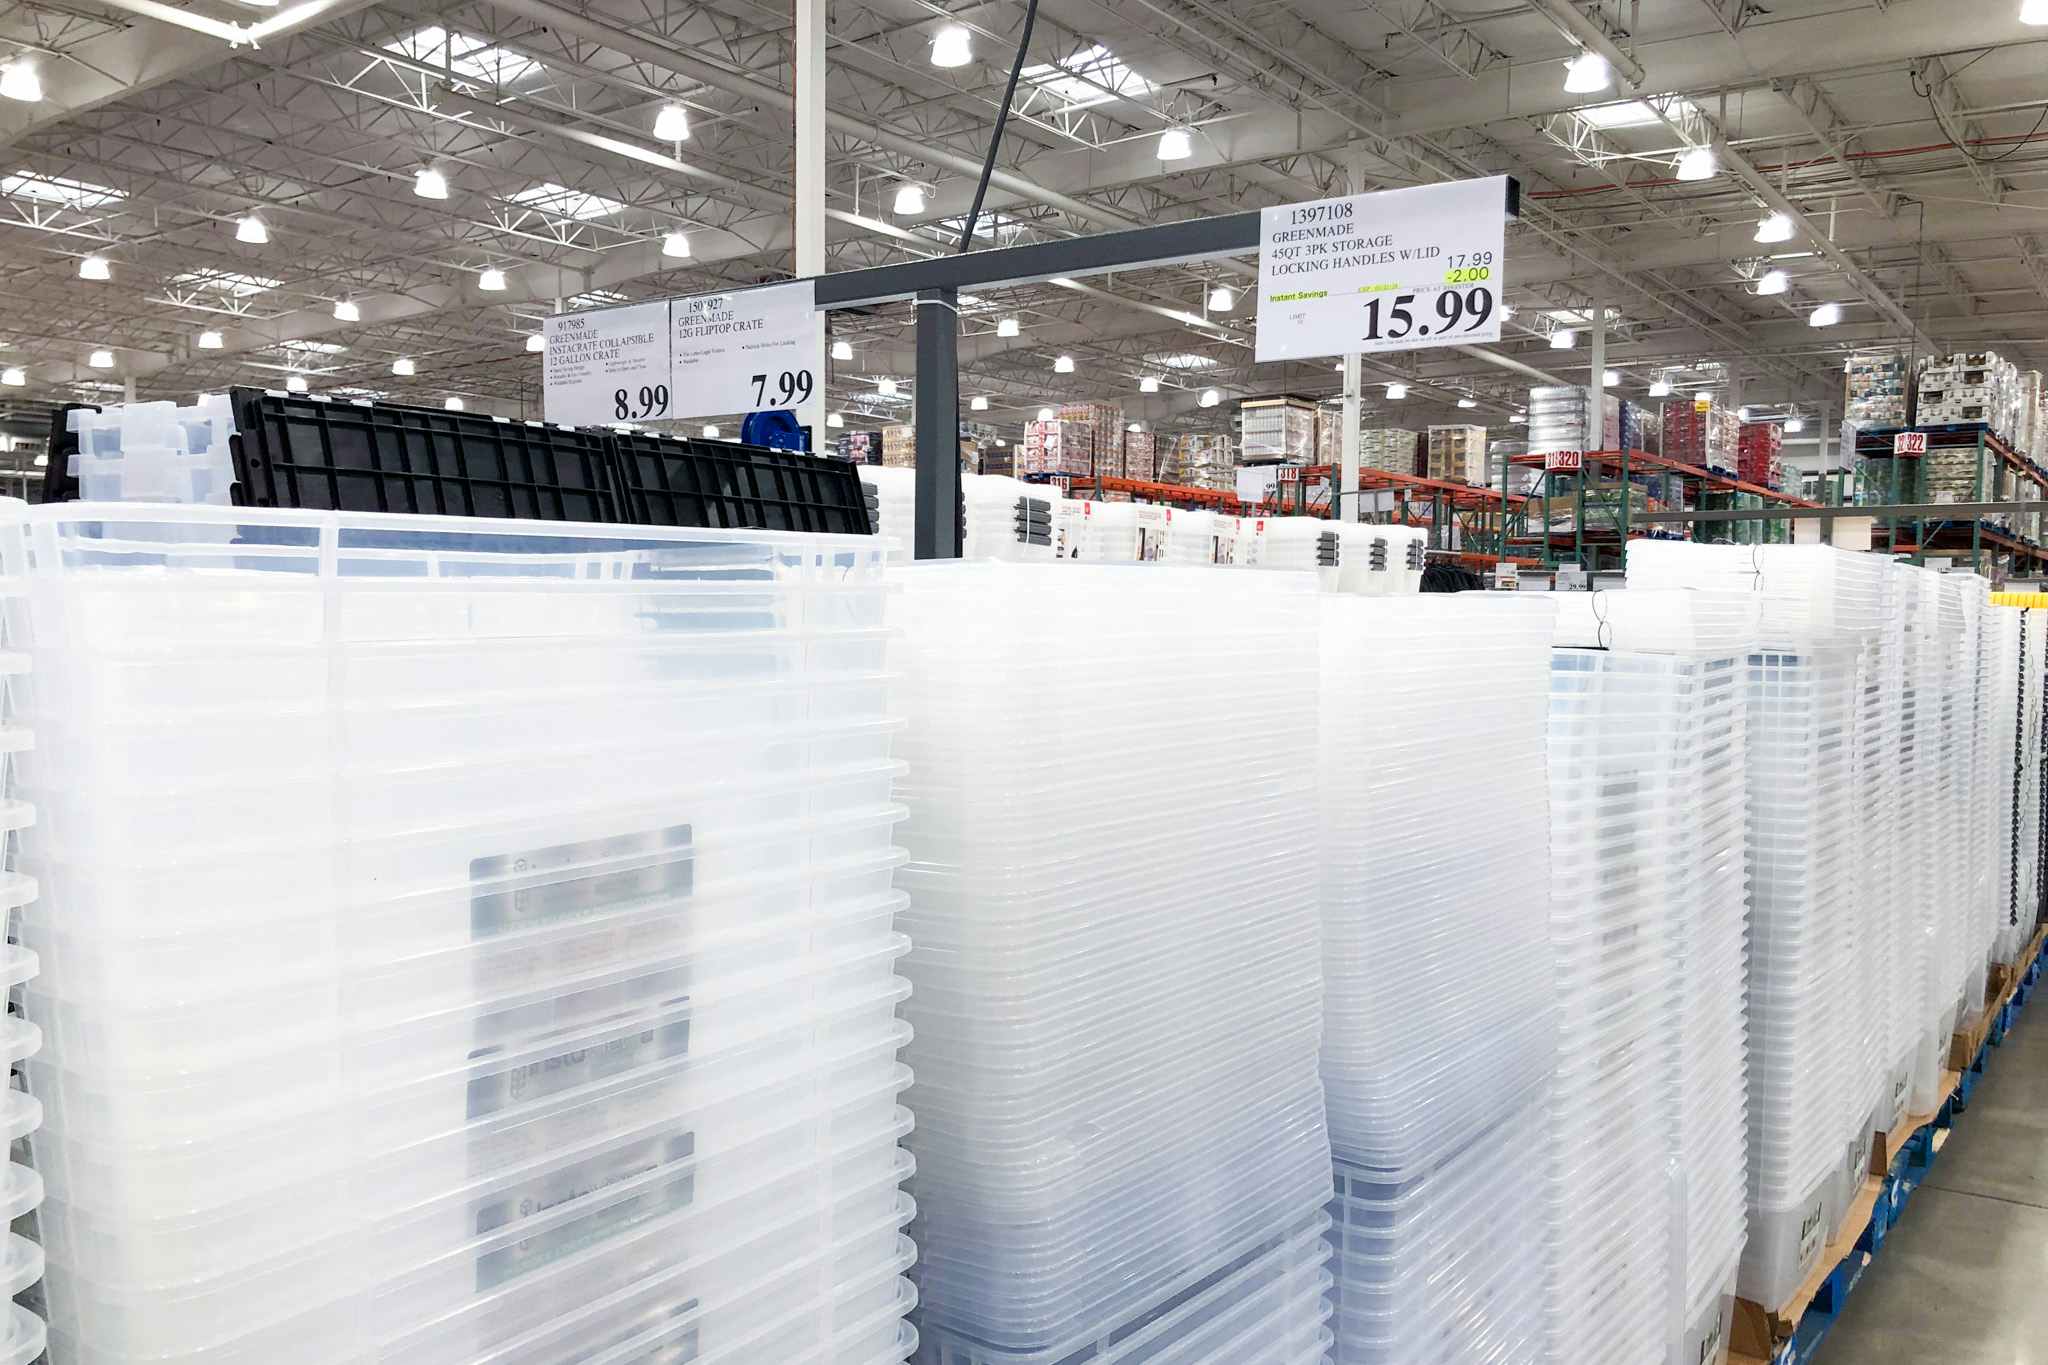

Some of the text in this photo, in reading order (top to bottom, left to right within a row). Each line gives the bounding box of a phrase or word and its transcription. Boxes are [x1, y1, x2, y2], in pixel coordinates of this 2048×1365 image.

[1291, 203, 1353, 225] 1397108
[1272, 223, 1354, 244] GREENMADE
[1271, 234, 1393, 260] 45QT 3PK STORAGE
[1271, 246, 1440, 276] LOCKING HANDLES W/LID
[1447, 251, 1493, 269] 17.99
[1447, 266, 1489, 283] -2.00
[1270, 290, 1328, 302] Instant Savings
[689, 298, 723, 313] 150927
[1362, 287, 1493, 341] 15.99
[558, 318, 585, 330] 917985
[678, 310, 734, 327] GREENMADE
[549, 329, 599, 344] GREENMADE
[679, 319, 764, 339] 12G FLIPTOP CRATE
[549, 333, 655, 356] INSTACRATE COLLAPSIBLE
[558, 353, 591, 365] GALLON
[593, 348, 620, 360] CRATE
[751, 369, 813, 407] 7.99
[614, 384, 669, 420] 8.99
[1907, 434, 1924, 451] 322
[1559, 451, 1579, 466] 320
[1280, 467, 1297, 479] 318
